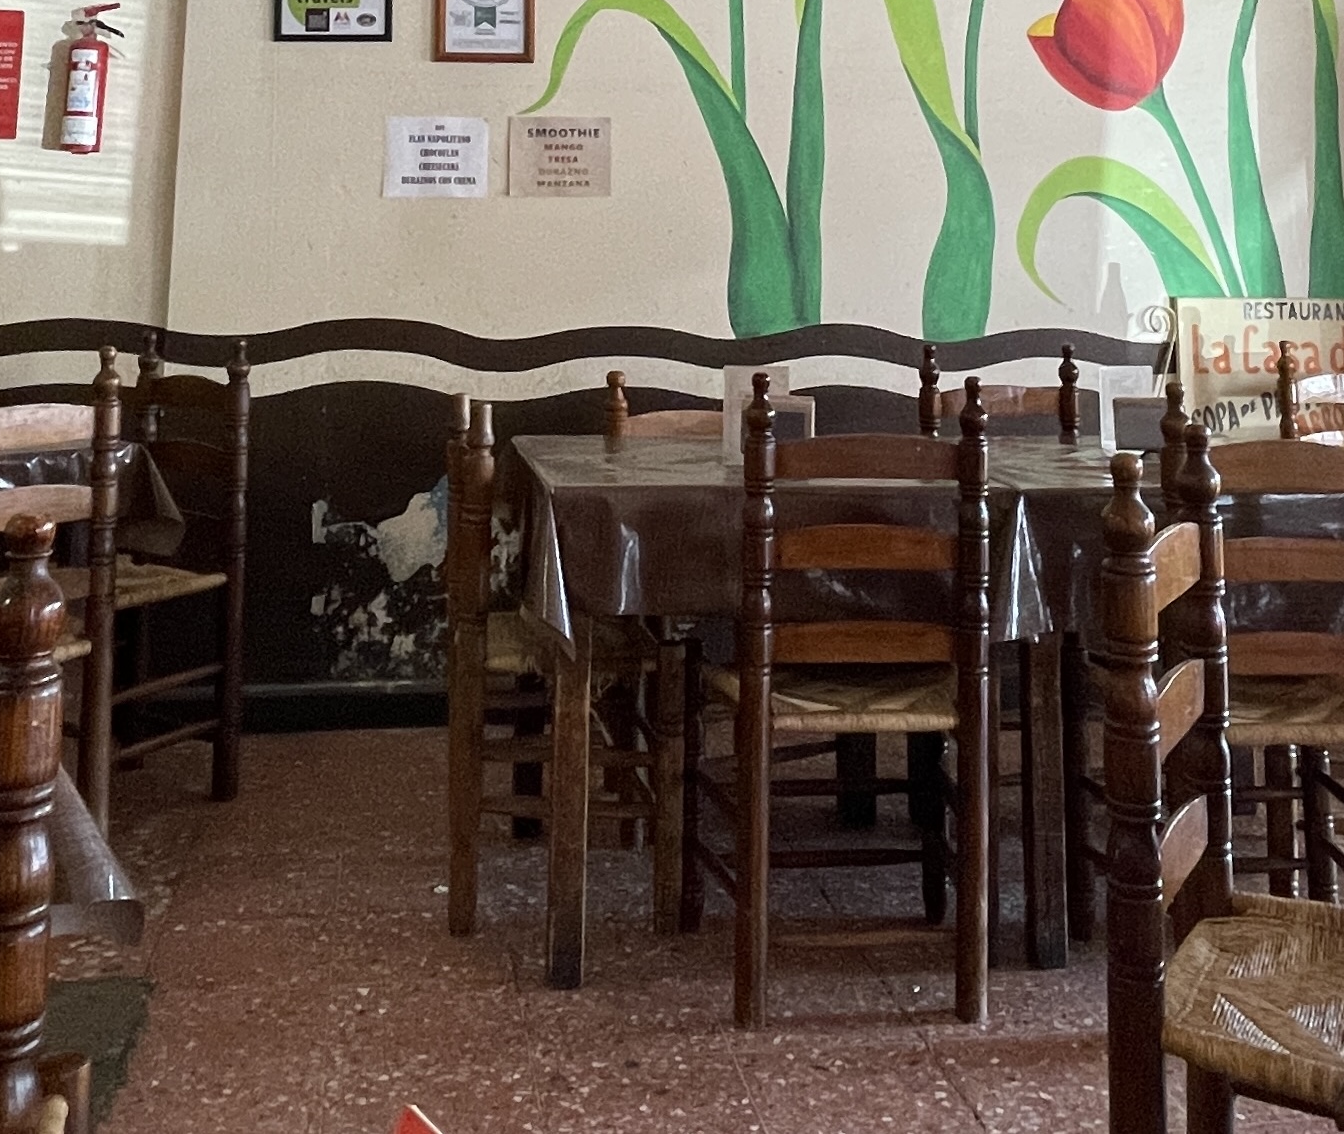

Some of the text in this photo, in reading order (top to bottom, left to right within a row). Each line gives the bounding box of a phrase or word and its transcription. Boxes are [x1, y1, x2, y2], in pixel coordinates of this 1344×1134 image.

[527, 128, 600, 138] SMOOTHIE
[543, 143, 584, 151] MANGO
[1191, 323, 1232, 375] La
[1242, 324, 1322, 375] Casa
